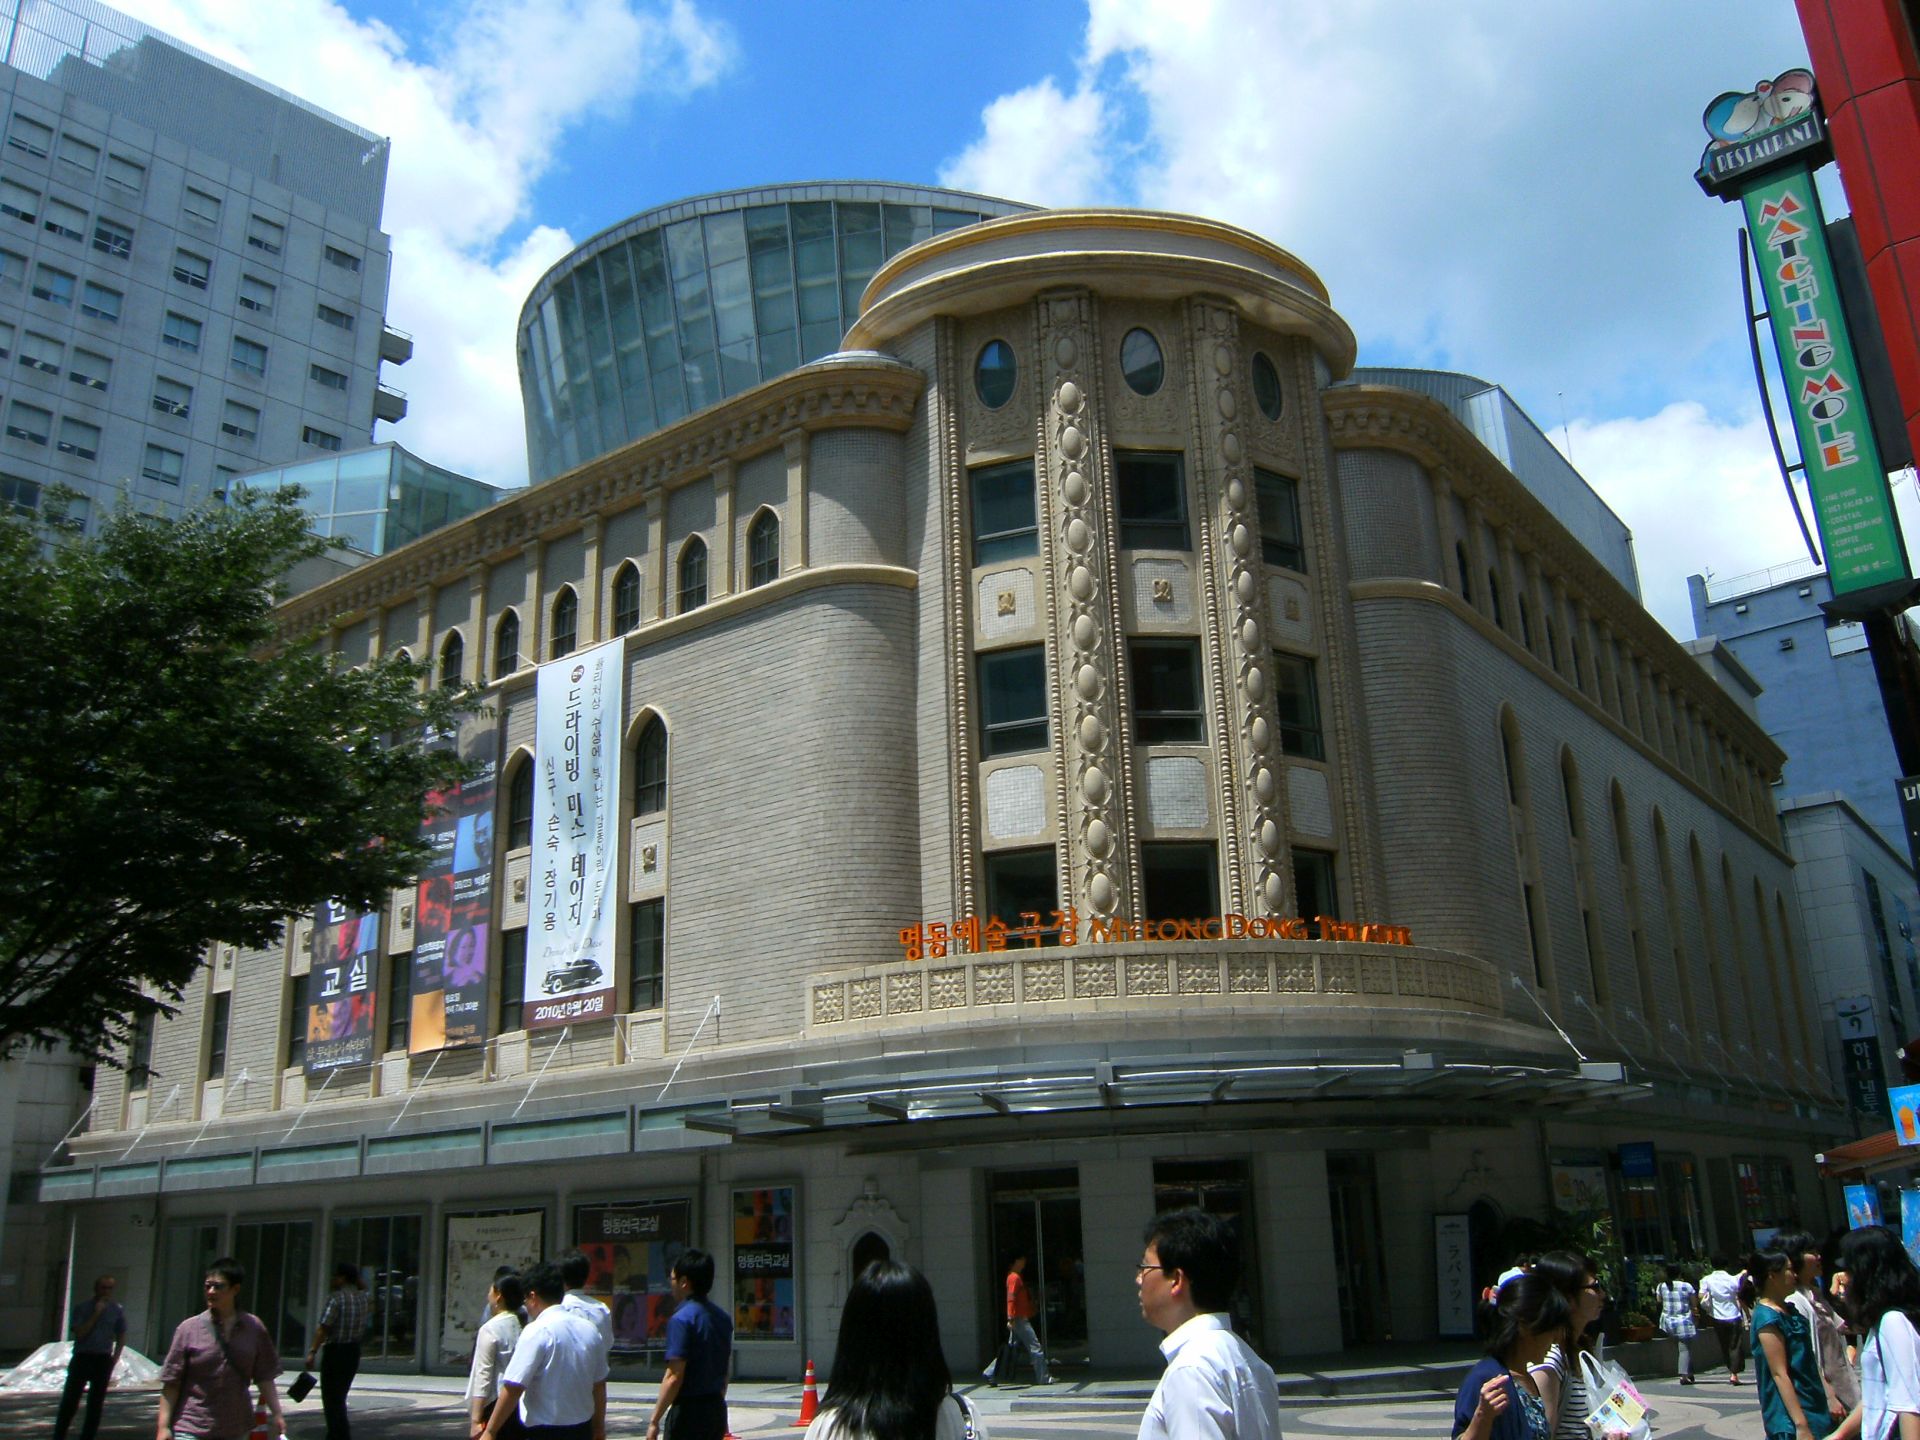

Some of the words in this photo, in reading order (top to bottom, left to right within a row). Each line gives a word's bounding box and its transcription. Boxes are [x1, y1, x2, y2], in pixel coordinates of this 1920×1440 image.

[1716, 121, 1813, 173] RESTAURANT
[1758, 191, 1835, 370] MATCHING
[1801, 367, 1859, 473] MOLE
[564, 687, 582, 782] 드라이빙
[546, 813, 560, 852] 손숙
[567, 792, 587, 840] 미스
[543, 868, 558, 931] 장기용
[568, 853, 586, 926] 데이지
[899, 905, 1081, 961] 명동예술극장
[1315, 915, 1413, 946] THEATER
[320, 955, 368, 997] 교실
[583, 996, 604, 1013] 20일
